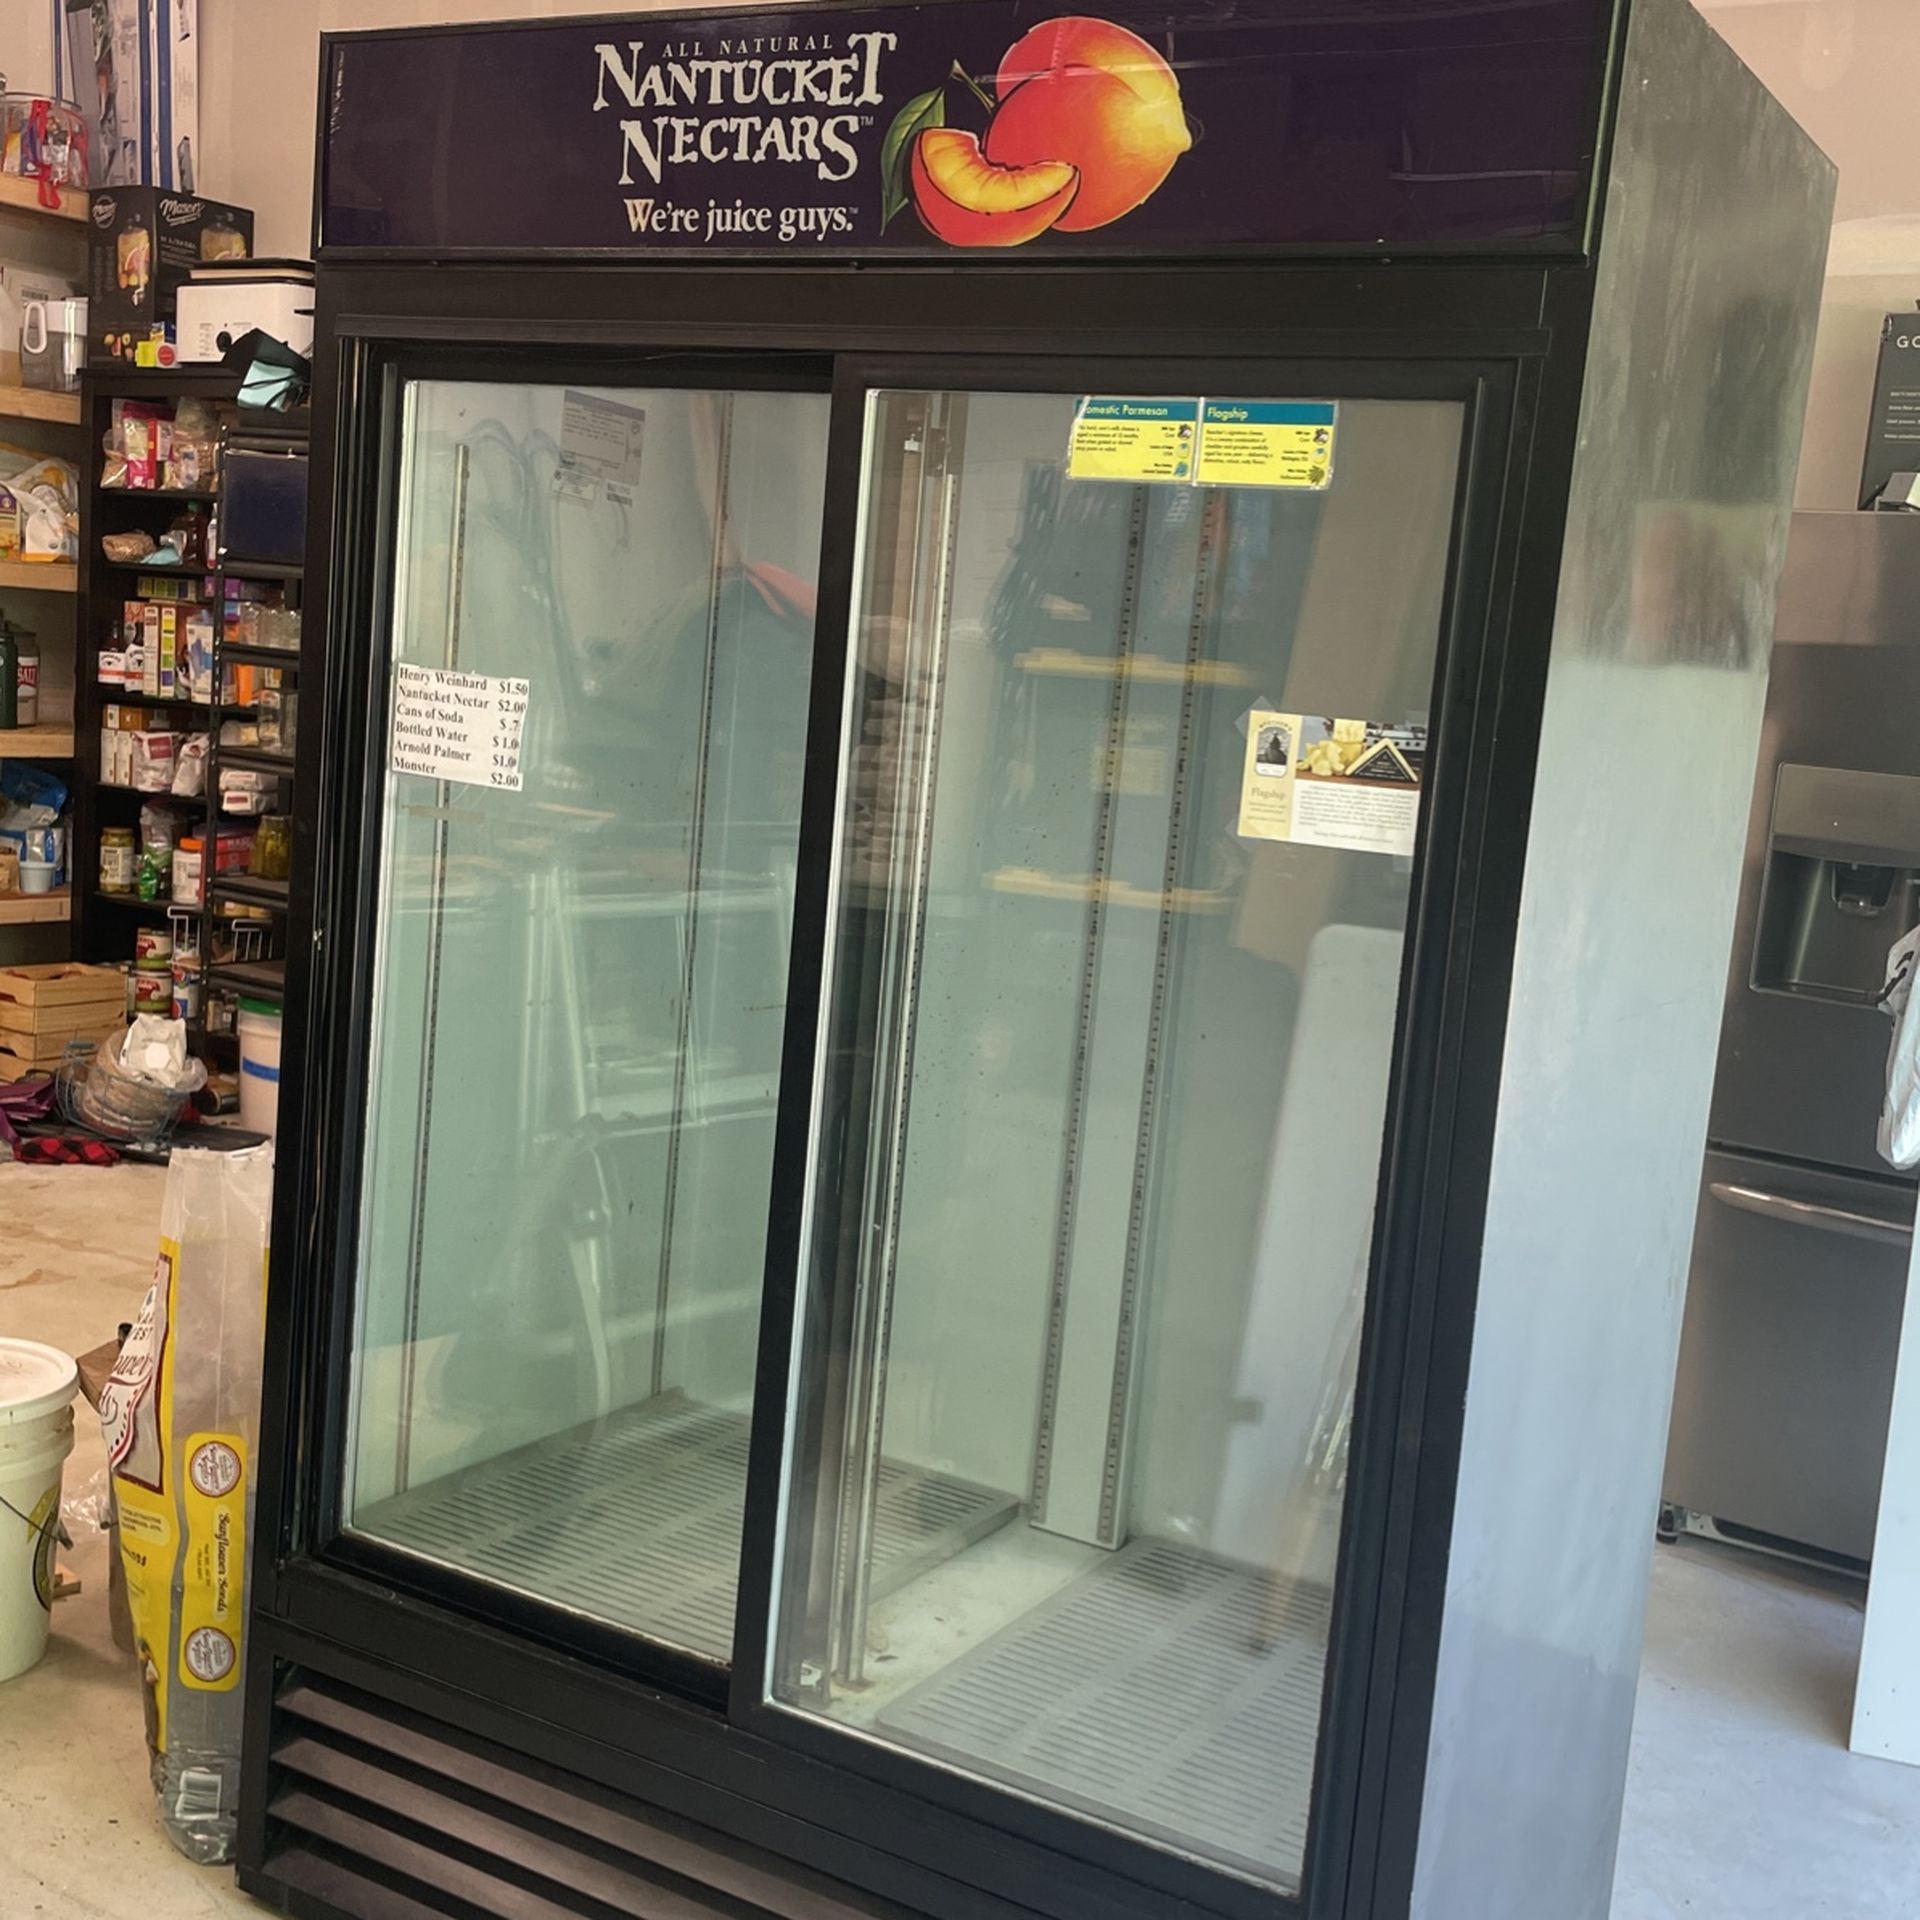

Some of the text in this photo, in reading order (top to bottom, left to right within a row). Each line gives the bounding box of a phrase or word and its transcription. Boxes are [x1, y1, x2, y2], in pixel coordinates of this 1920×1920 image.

[661, 34, 833, 58] ALL NATURAL
[592, 31, 898, 112] NANTUCKET
[618, 115, 860, 186] NECTARS
[623, 198, 700, 232] We're
[704, 198, 772, 242] juice
[1084, 403, 1169, 417] omestic Parmesan
[1207, 406, 1249, 421] Flagship
[399, 667, 431, 686] Henry
[434, 672, 488, 691] Weinhard
[398, 684, 451, 703] Nantucket
[453, 692, 490, 710] Nectar
[396, 702, 423, 718] Cans
[424, 707, 436, 720] of
[437, 708, 464, 724] Soda
[395, 721, 433, 738] Bottled
[434, 726, 469, 743] Water
[394, 740, 431, 756] Arnold
[433, 744, 472, 762] Palmer
[393, 756, 437, 774] Monster
[214, 1512, 231, 1612] Sunflower Seeds
